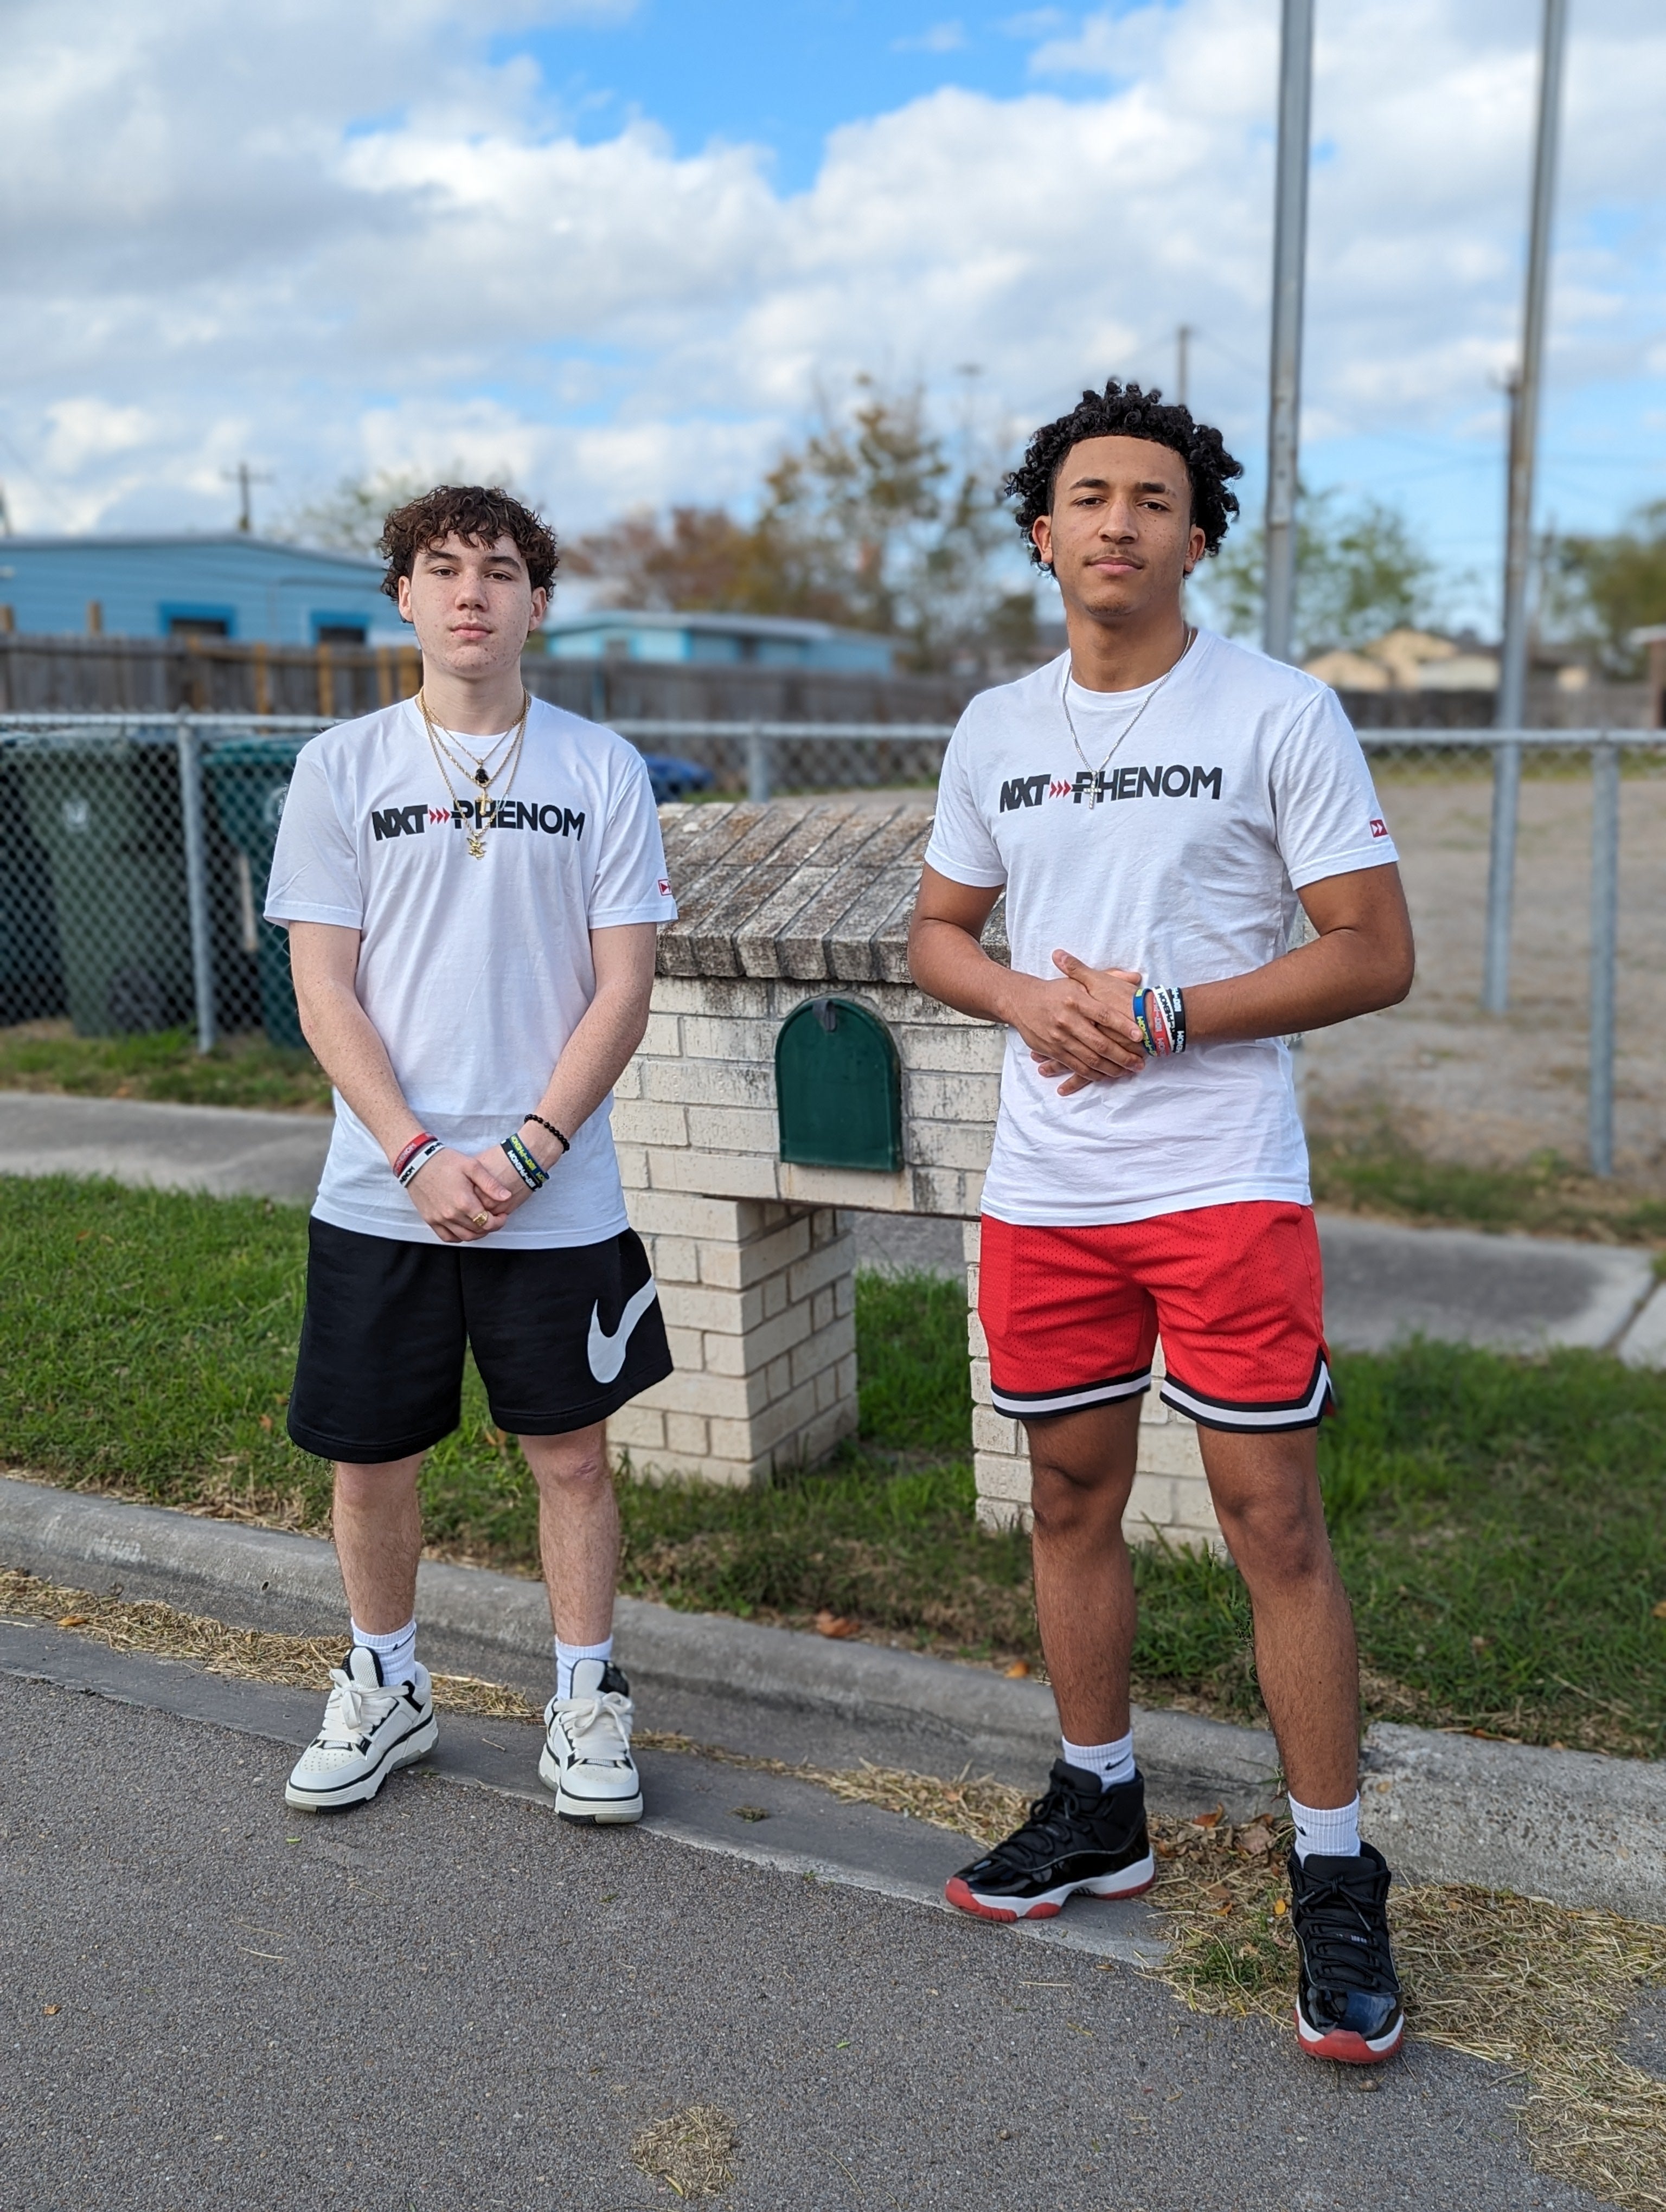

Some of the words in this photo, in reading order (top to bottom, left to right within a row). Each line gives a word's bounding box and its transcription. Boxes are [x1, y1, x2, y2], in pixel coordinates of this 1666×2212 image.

[999, 774, 1051, 813] NXT
[1071, 764, 1222, 803] PHENOM
[372, 805, 428, 841] NXT
[451, 800, 585, 841] PHENOM
